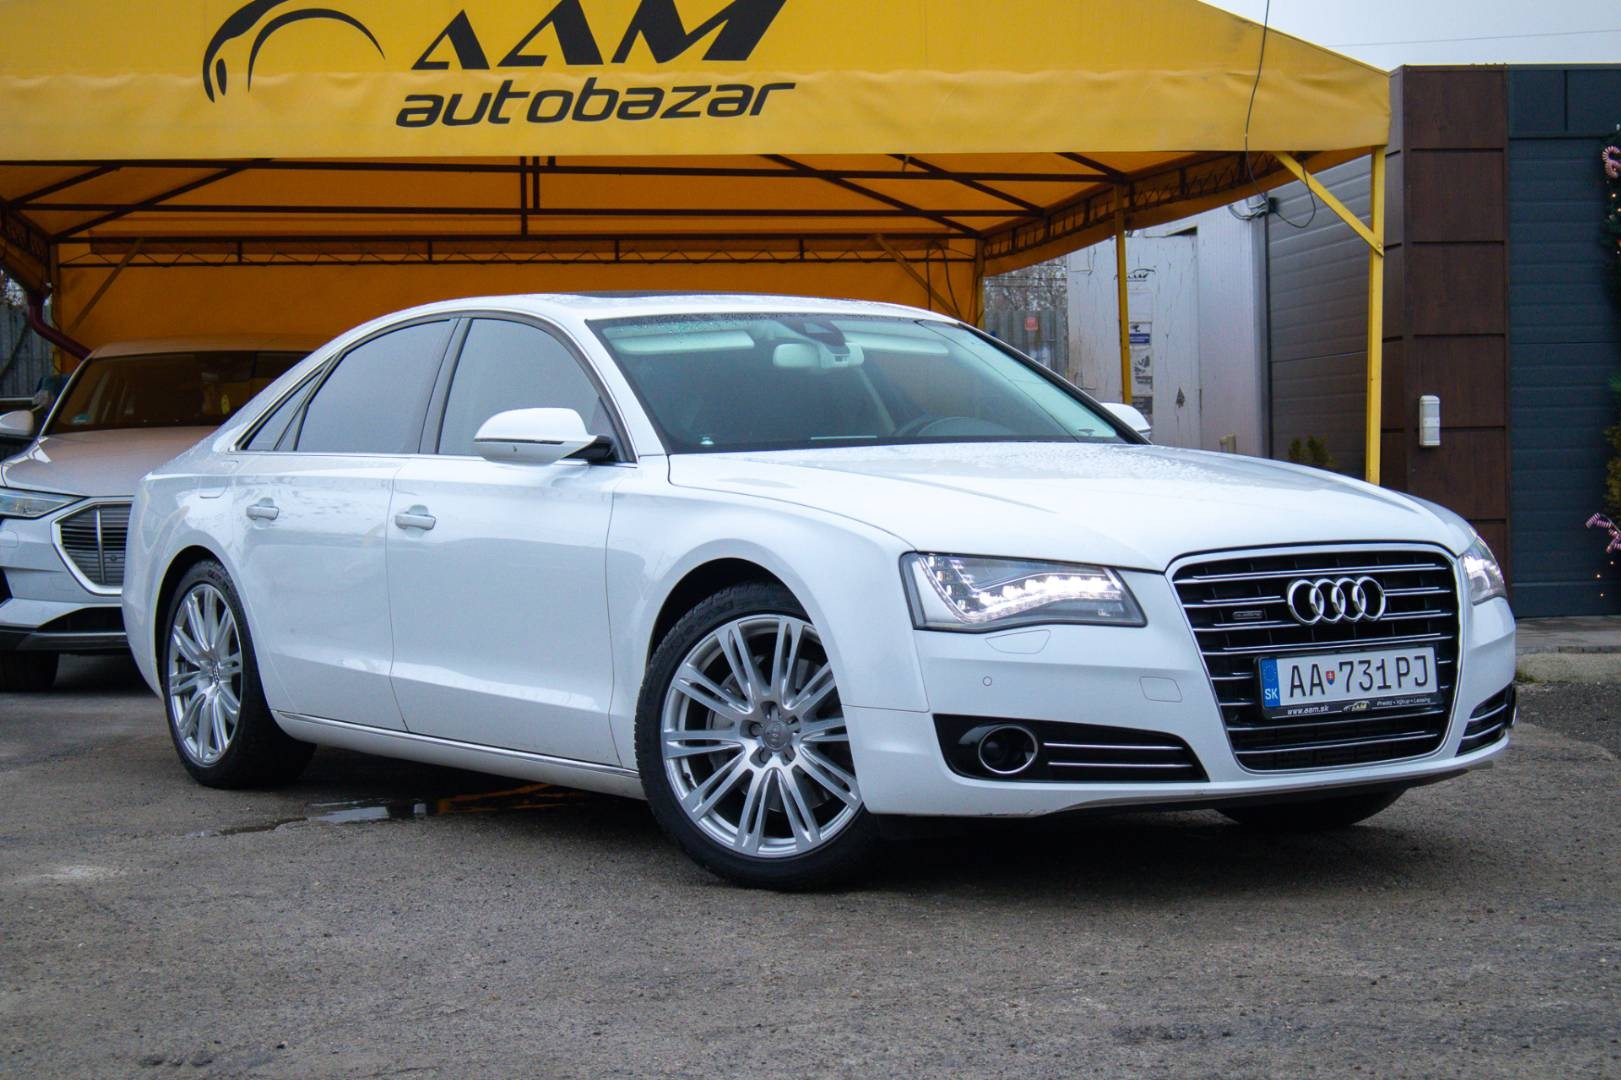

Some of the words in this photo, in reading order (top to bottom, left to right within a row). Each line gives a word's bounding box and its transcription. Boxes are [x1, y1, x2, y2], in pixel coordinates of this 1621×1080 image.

[410, 0, 788, 70] AAM
[395, 77, 796, 128] autobazar
[1264, 687, 1279, 700] SK
[1289, 663, 1326, 698] AA
[1338, 655, 1429, 693] 731PJ
[1287, 705, 1329, 715] www.aam.sk
